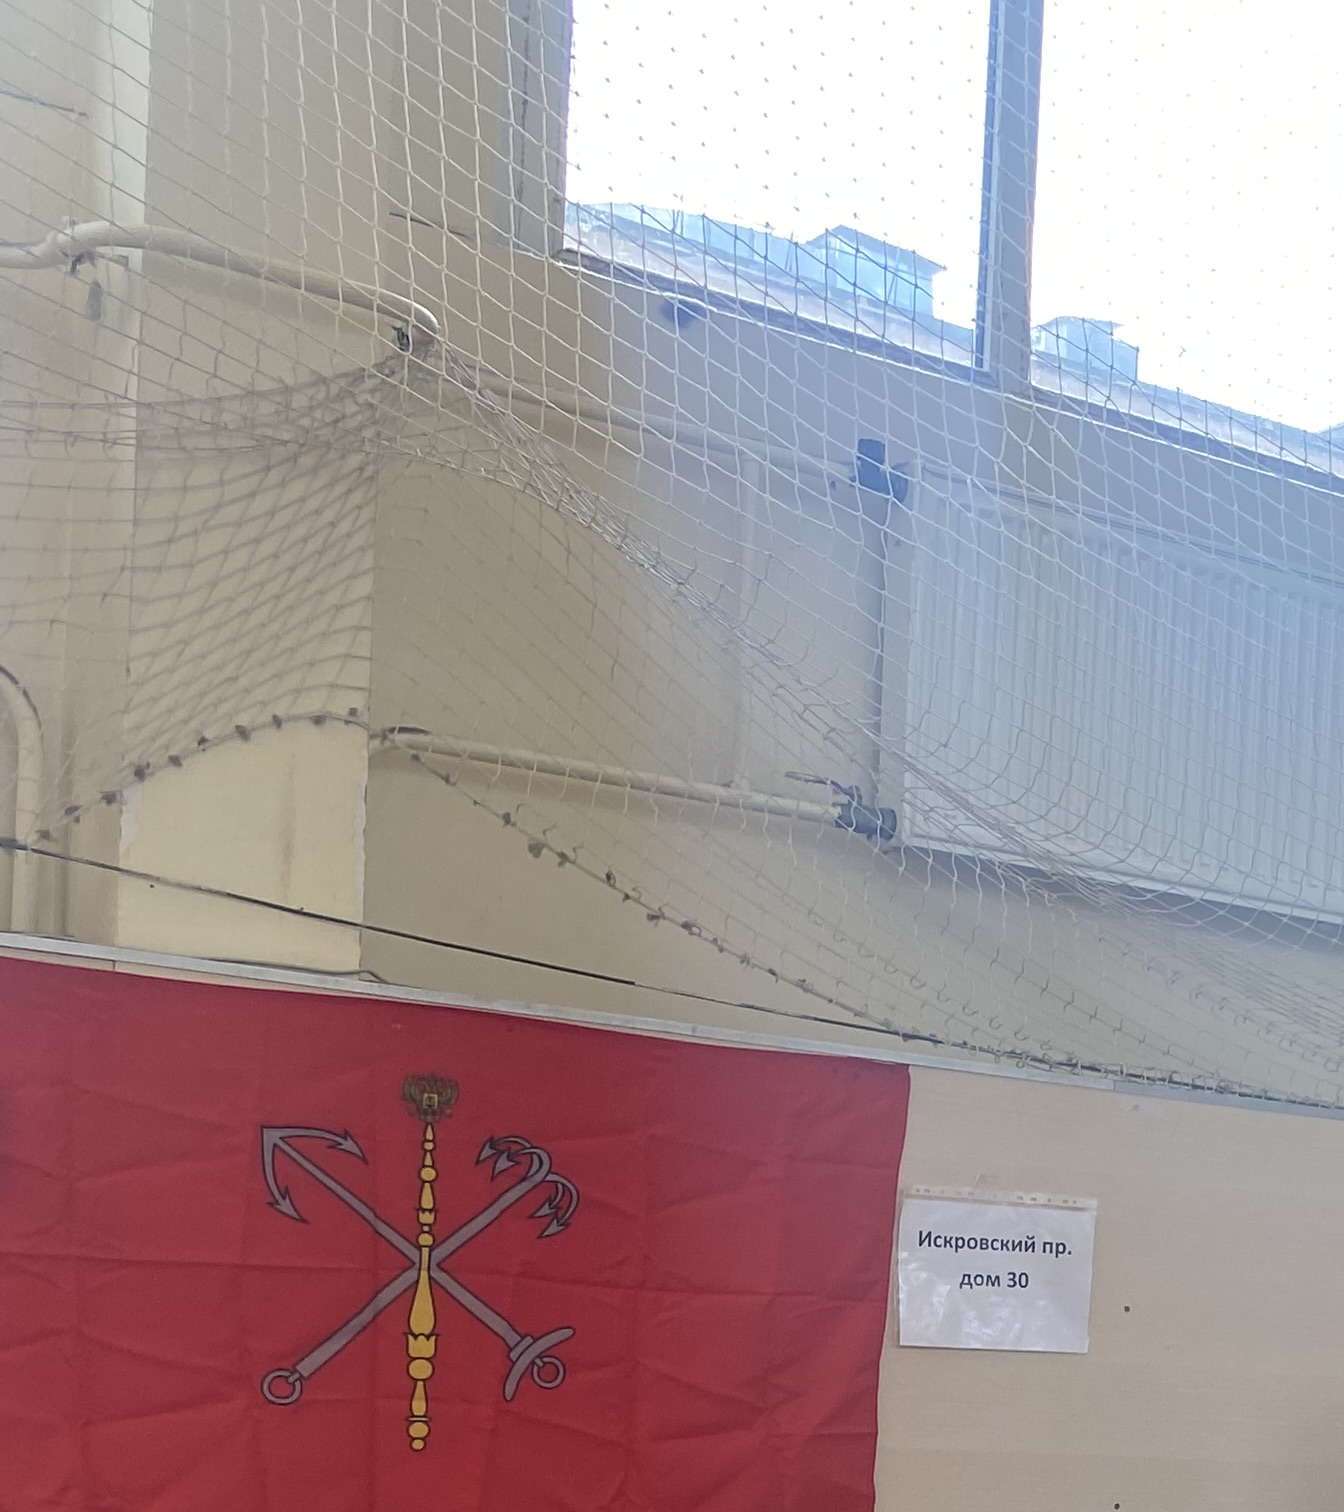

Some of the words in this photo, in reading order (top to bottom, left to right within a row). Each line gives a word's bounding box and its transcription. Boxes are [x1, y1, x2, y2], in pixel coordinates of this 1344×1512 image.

[917, 1229, 1037, 1254] Искровский
[1042, 1240, 1073, 1258] пр.
[959, 1272, 1001, 1290] дом
[1006, 1271, 1030, 1289] 30
